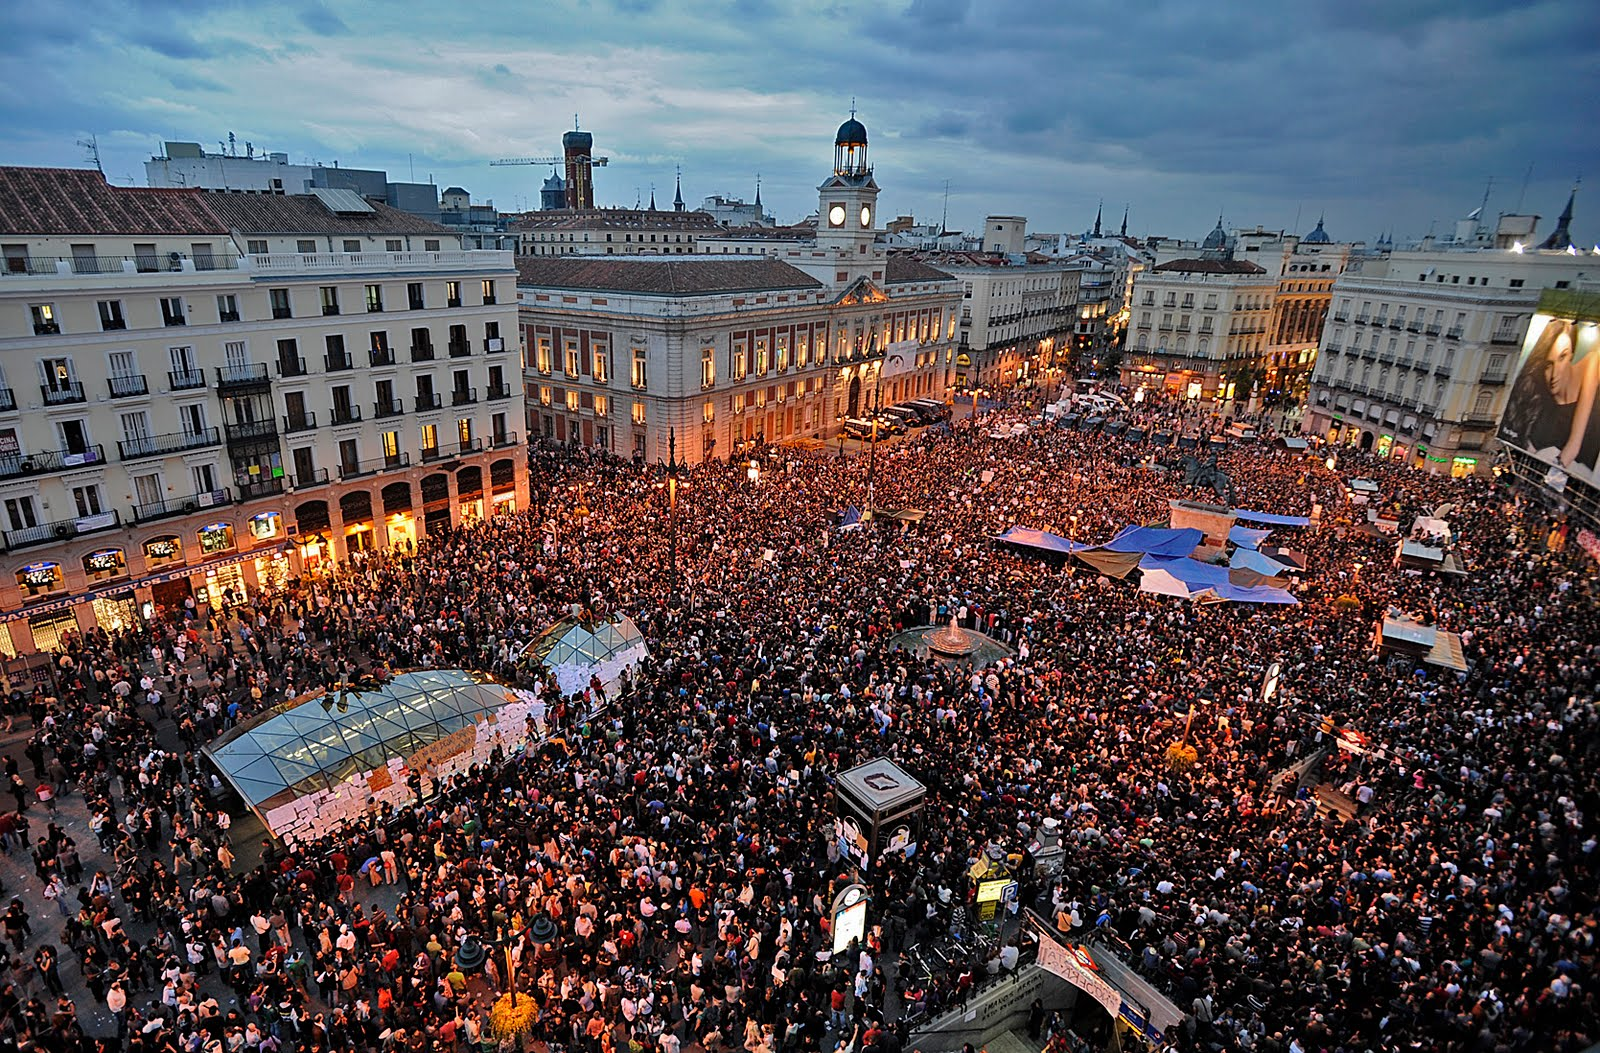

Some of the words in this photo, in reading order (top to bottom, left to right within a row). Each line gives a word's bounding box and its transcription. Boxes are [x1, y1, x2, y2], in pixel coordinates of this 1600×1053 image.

[95, 577, 161, 598] NUEVOS
[169, 548, 278, 580] GUERRILLEROS
[1005, 886, 1015, 900] P
